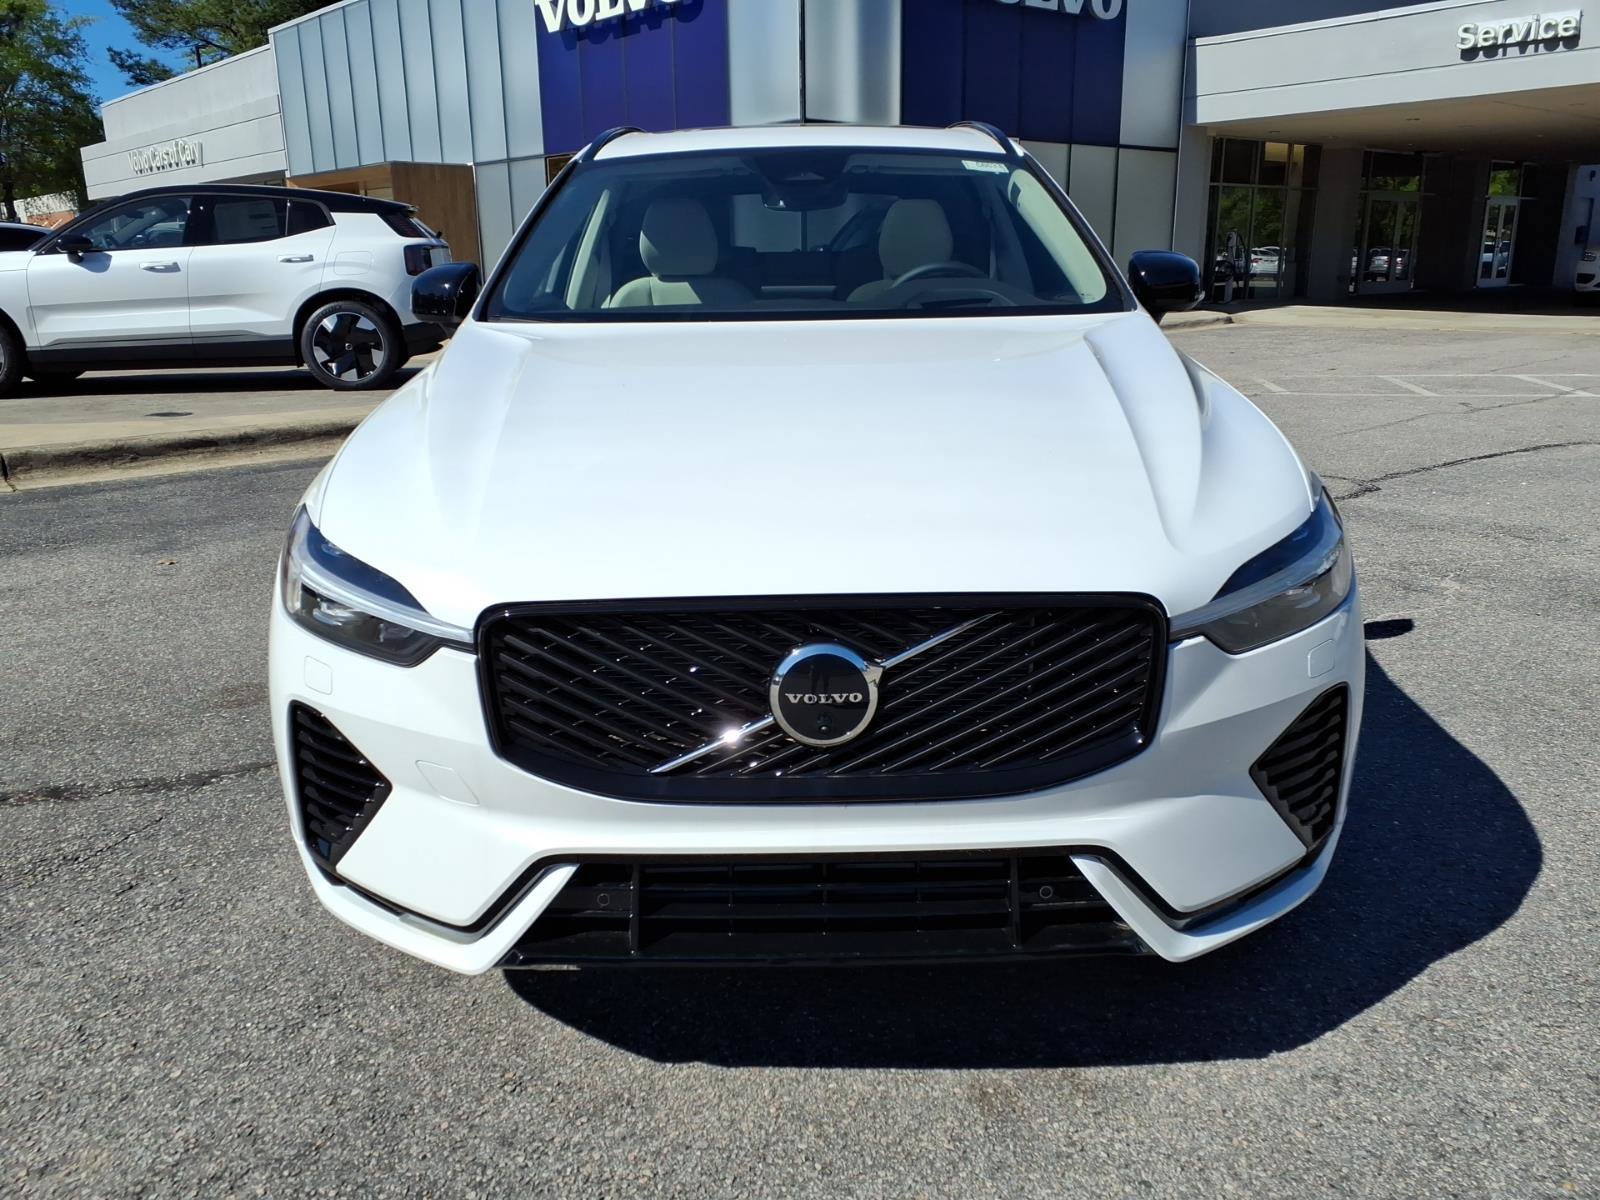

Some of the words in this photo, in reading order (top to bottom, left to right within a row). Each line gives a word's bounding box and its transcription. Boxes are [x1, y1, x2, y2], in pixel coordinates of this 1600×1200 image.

[535, 0, 680, 33] VOL
[1457, 14, 1578, 50] Service
[149, 147, 169, 167] Cars
[169, 141, 178, 164] of
[785, 692, 863, 704] VOLVO
